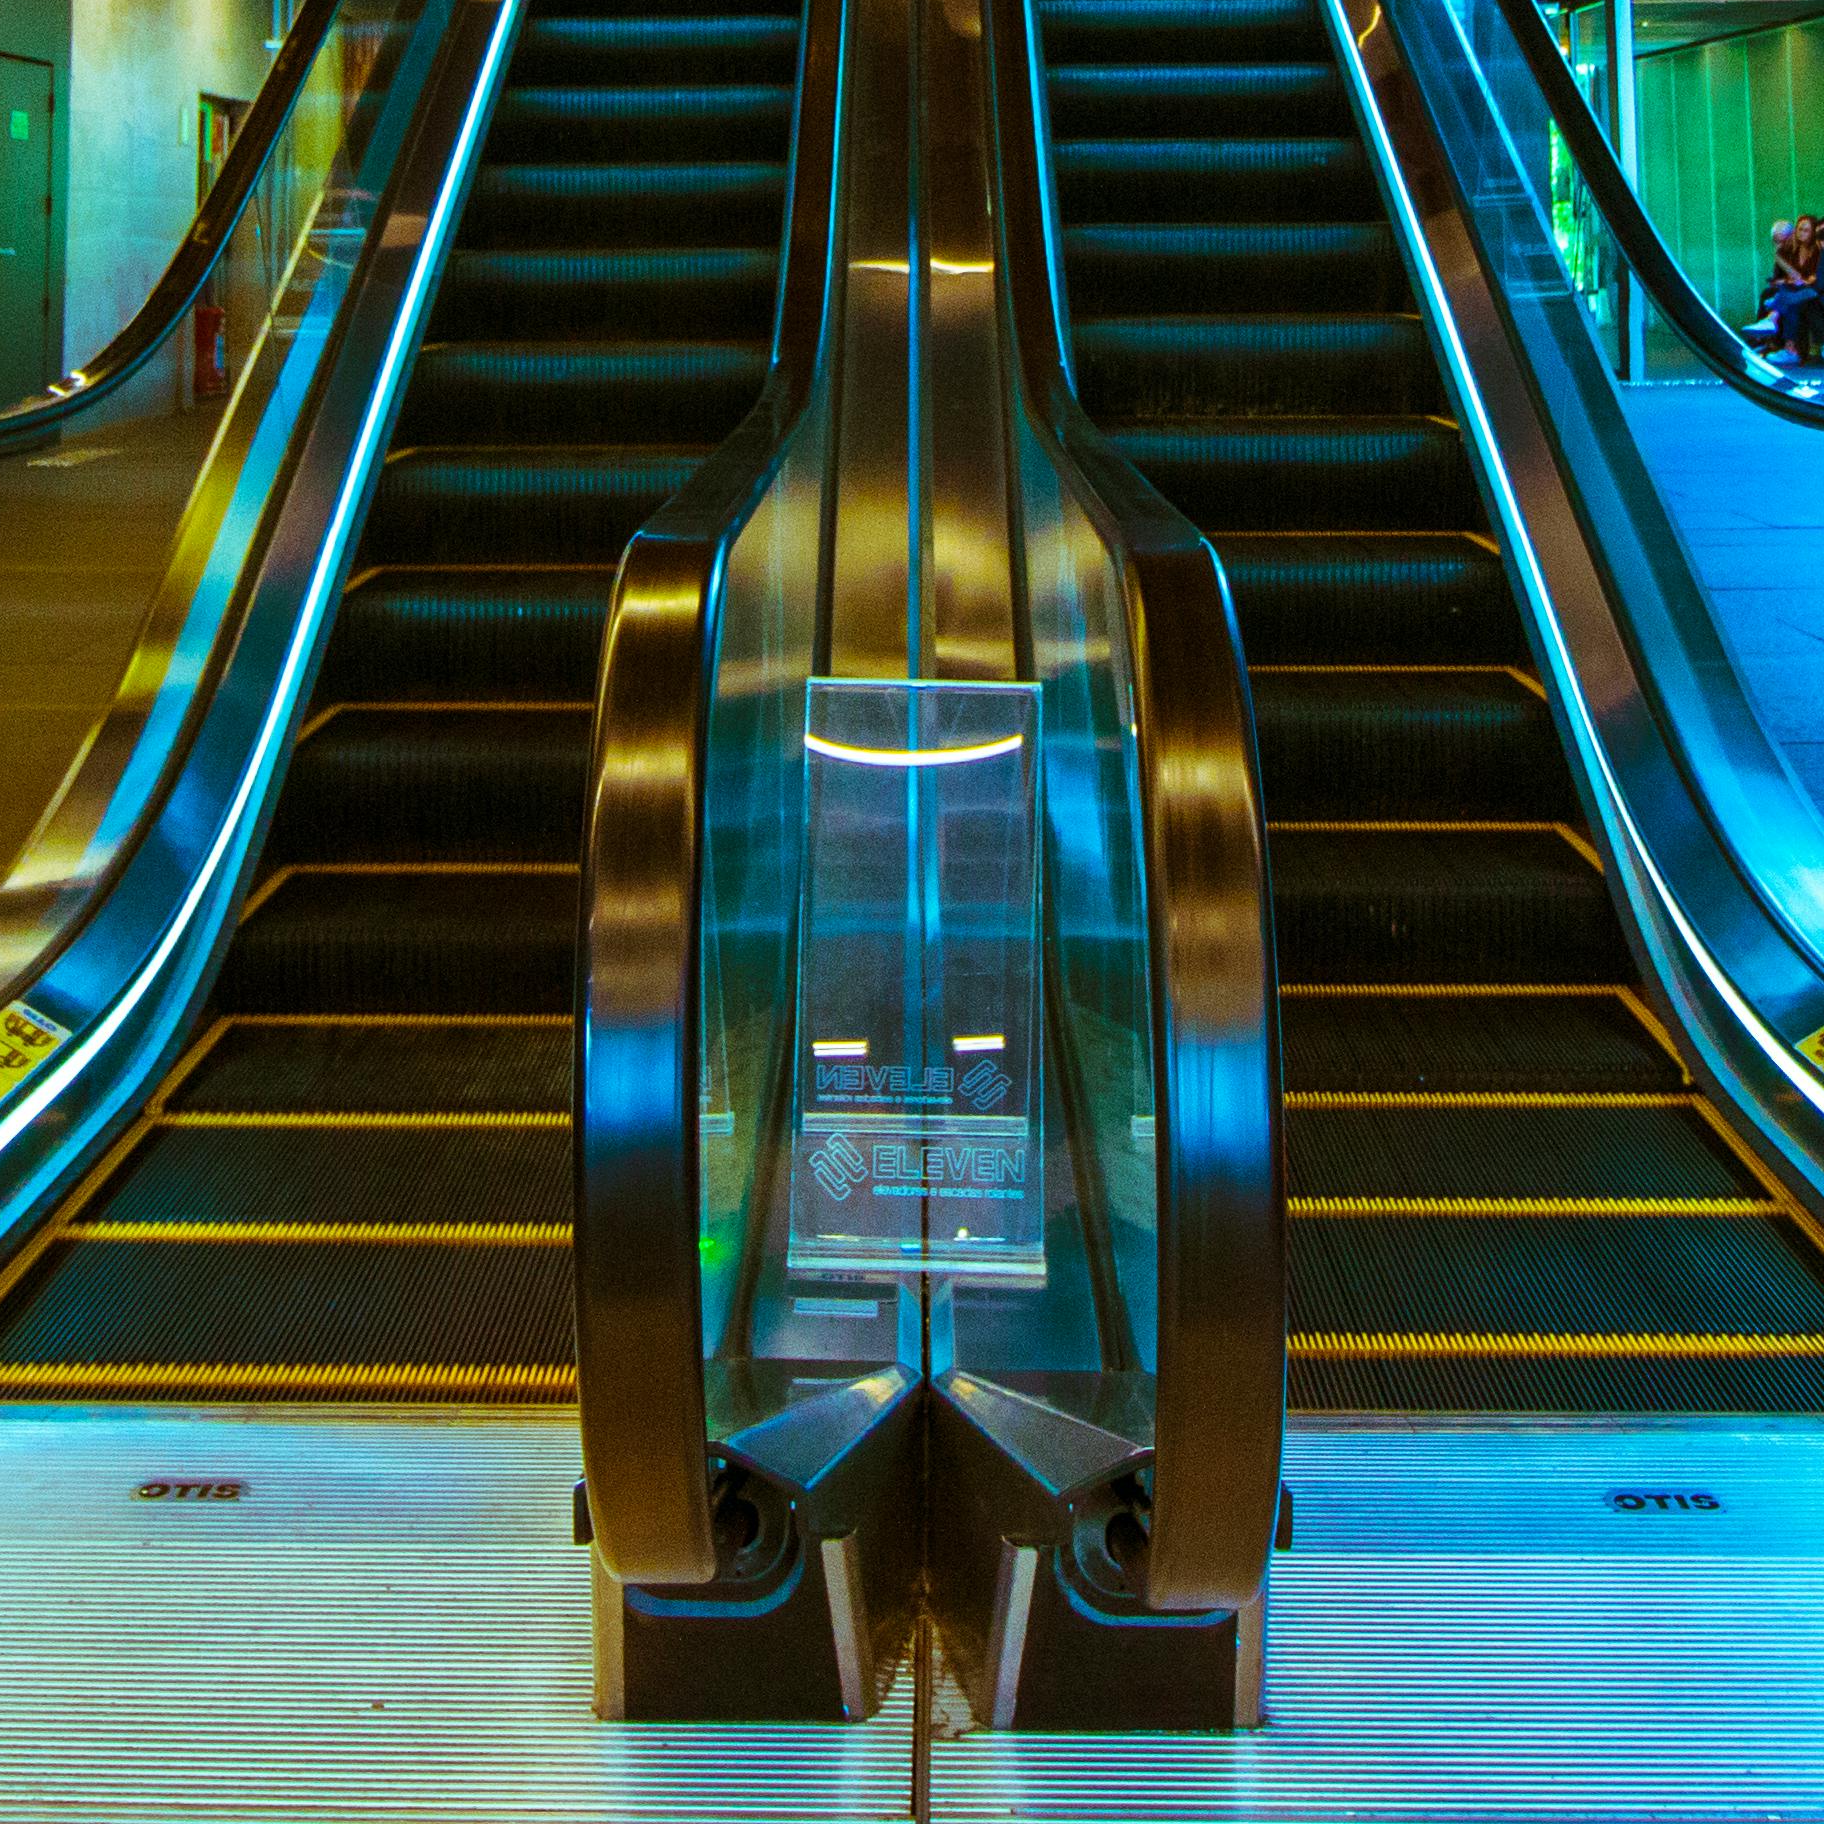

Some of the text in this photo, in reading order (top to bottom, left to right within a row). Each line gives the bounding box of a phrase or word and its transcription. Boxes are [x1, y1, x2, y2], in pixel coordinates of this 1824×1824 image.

[872, 1144, 1025, 1183] ELEVEN
[872, 1185, 1025, 1199] elevadores e escadas rolantes
[138, 1482, 241, 1501] OTIS
[1613, 1494, 1720, 1510] OTIS
